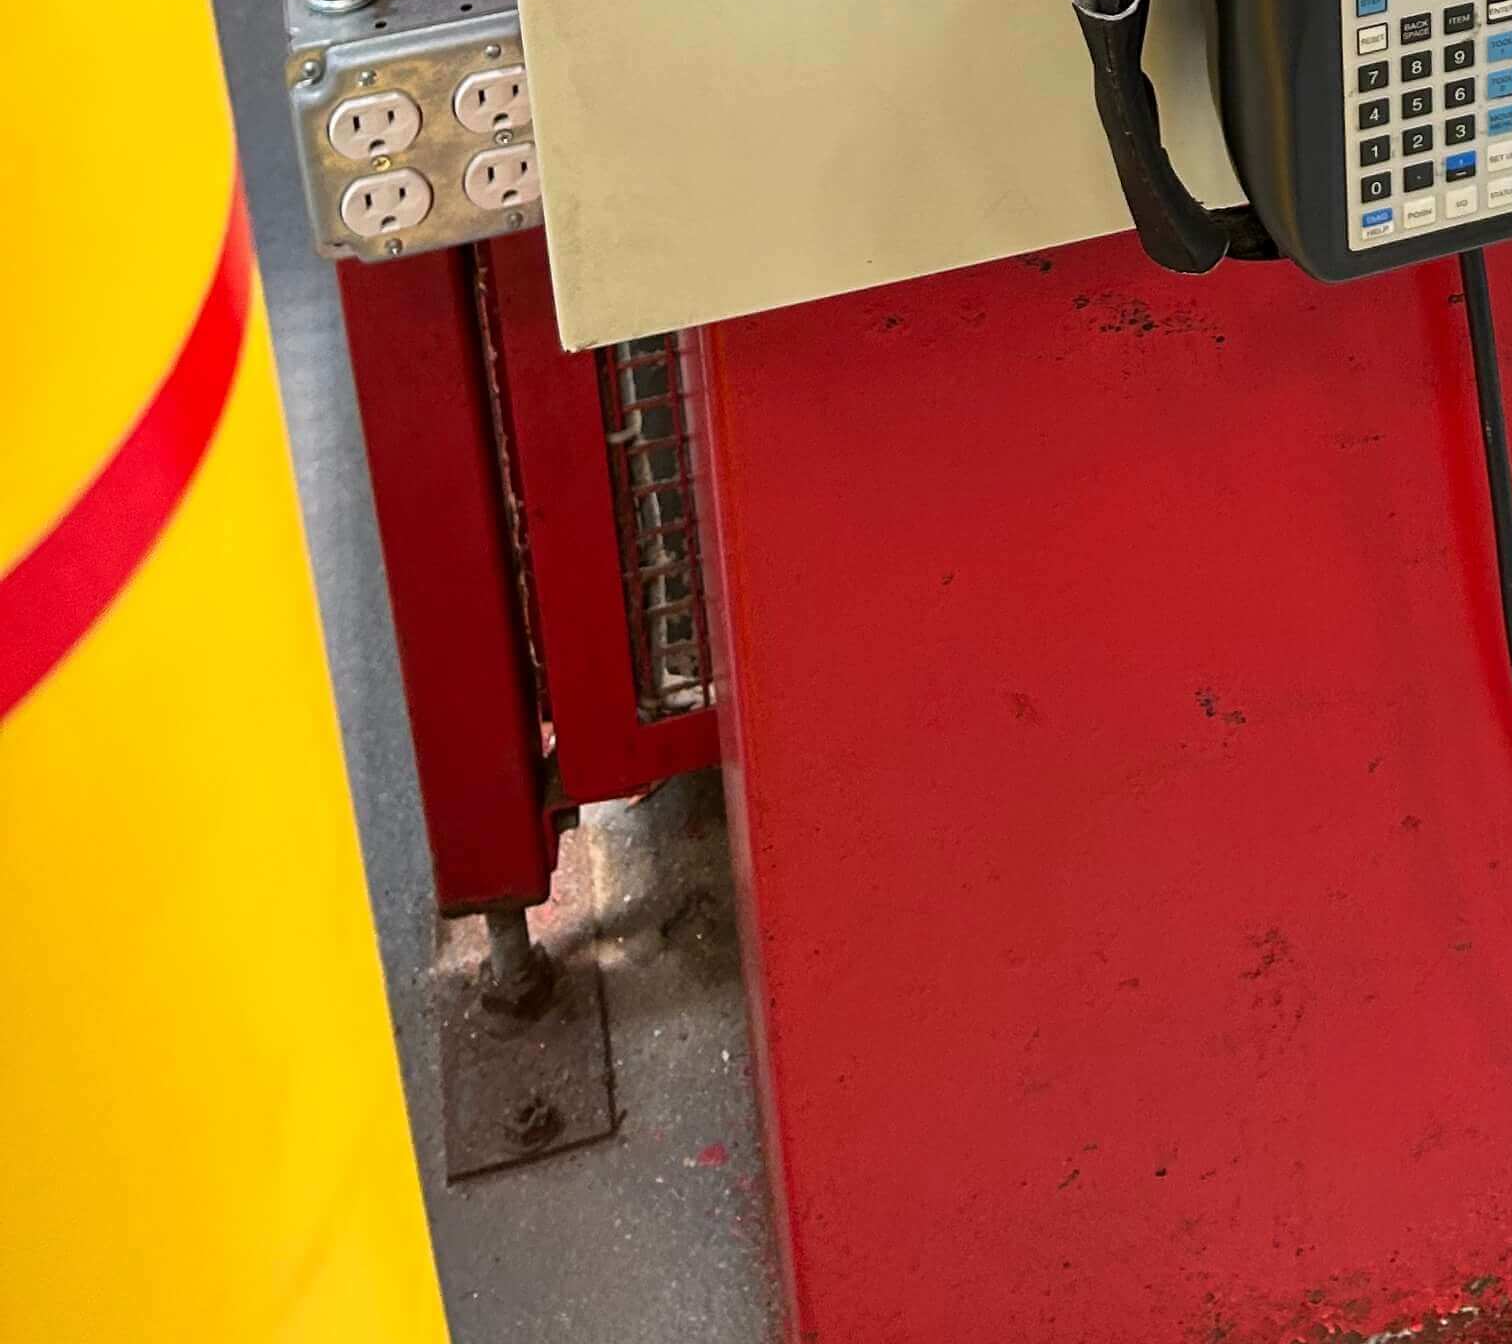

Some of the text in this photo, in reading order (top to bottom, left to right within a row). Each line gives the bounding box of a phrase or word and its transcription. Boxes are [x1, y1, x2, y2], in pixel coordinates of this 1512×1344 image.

[1448, 14, 1471, 25] ITEM
[1454, 50, 1465, 64] 9
[1411, 60, 1423, 74] 8
[1368, 70, 1379, 85] 7
[1454, 87, 1466, 101] 6
[1412, 97, 1423, 111] 5
[1369, 107, 1379, 121] 4
[1455, 124, 1466, 138] 3
[1412, 134, 1423, 149] 2
[1371, 145, 1378, 158] 1
[1371, 181, 1382, 195] 0
